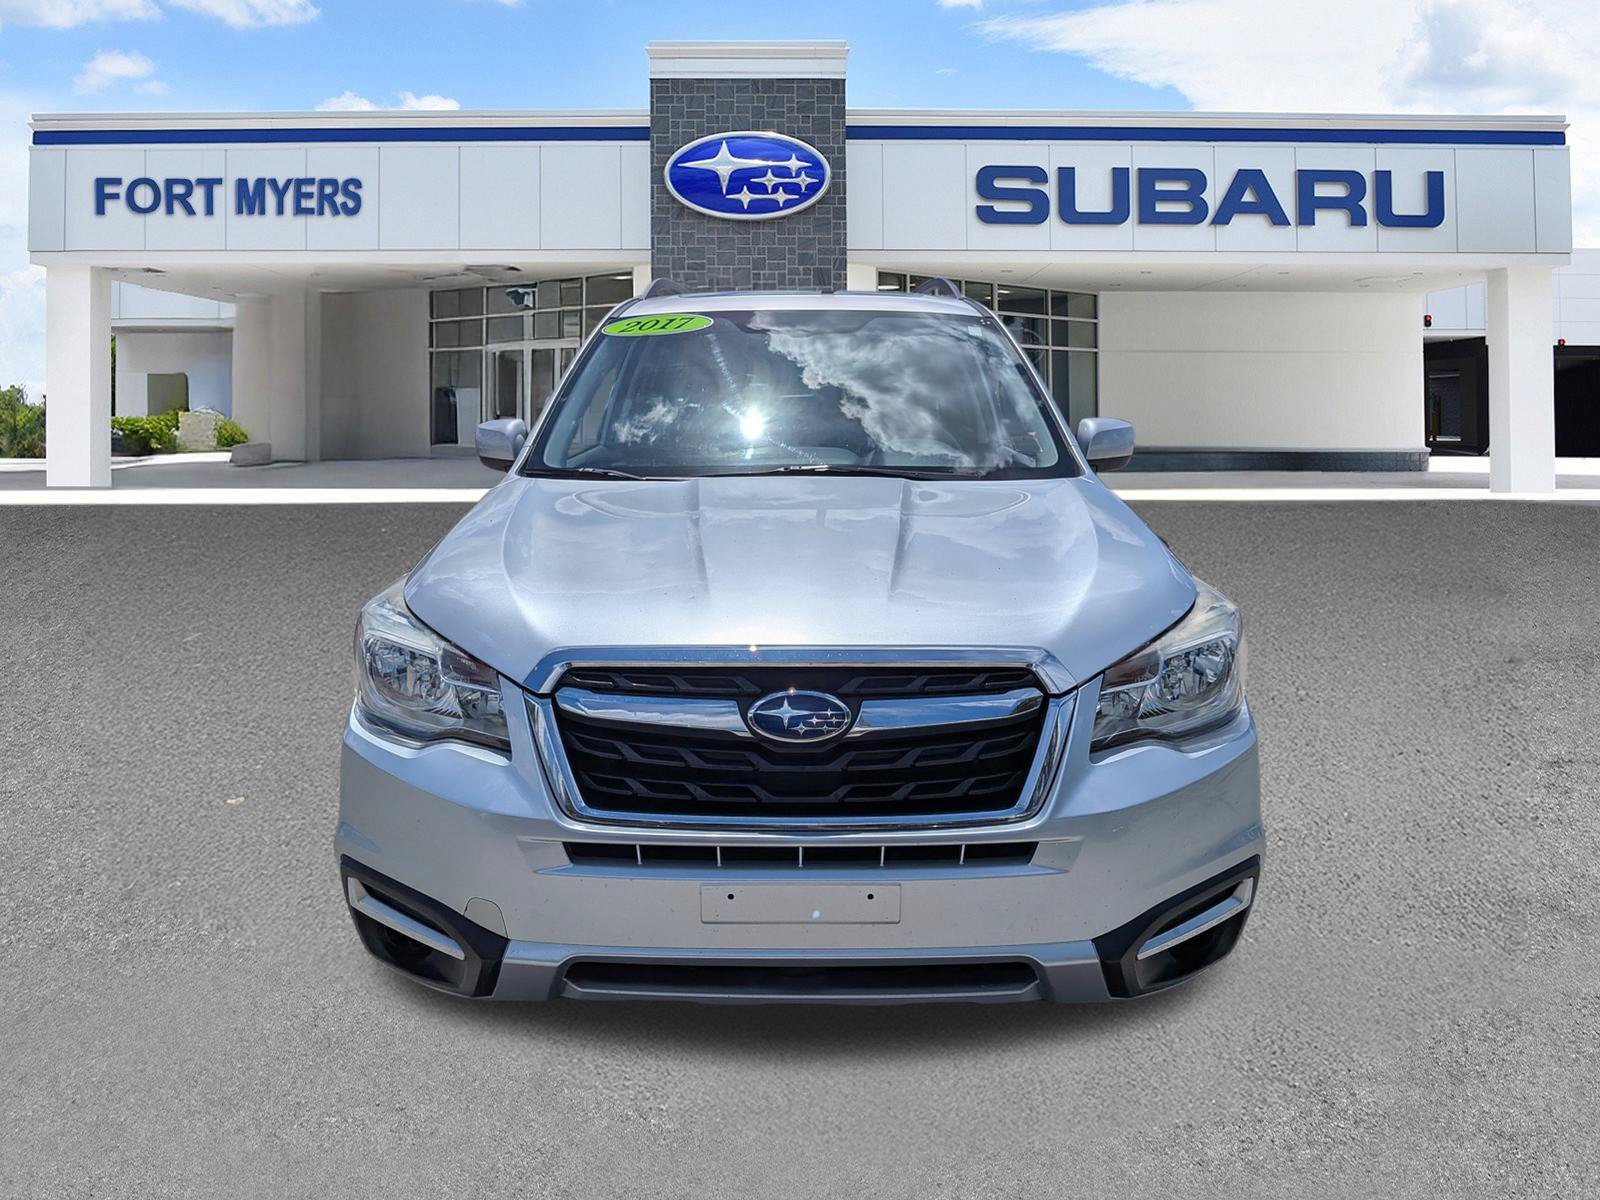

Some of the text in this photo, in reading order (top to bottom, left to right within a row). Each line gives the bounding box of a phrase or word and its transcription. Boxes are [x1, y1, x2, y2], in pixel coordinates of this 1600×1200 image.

[94, 177, 363, 217] FORT MYERS
[975, 165, 1446, 228] SUBARU
[618, 317, 695, 333] 2017
